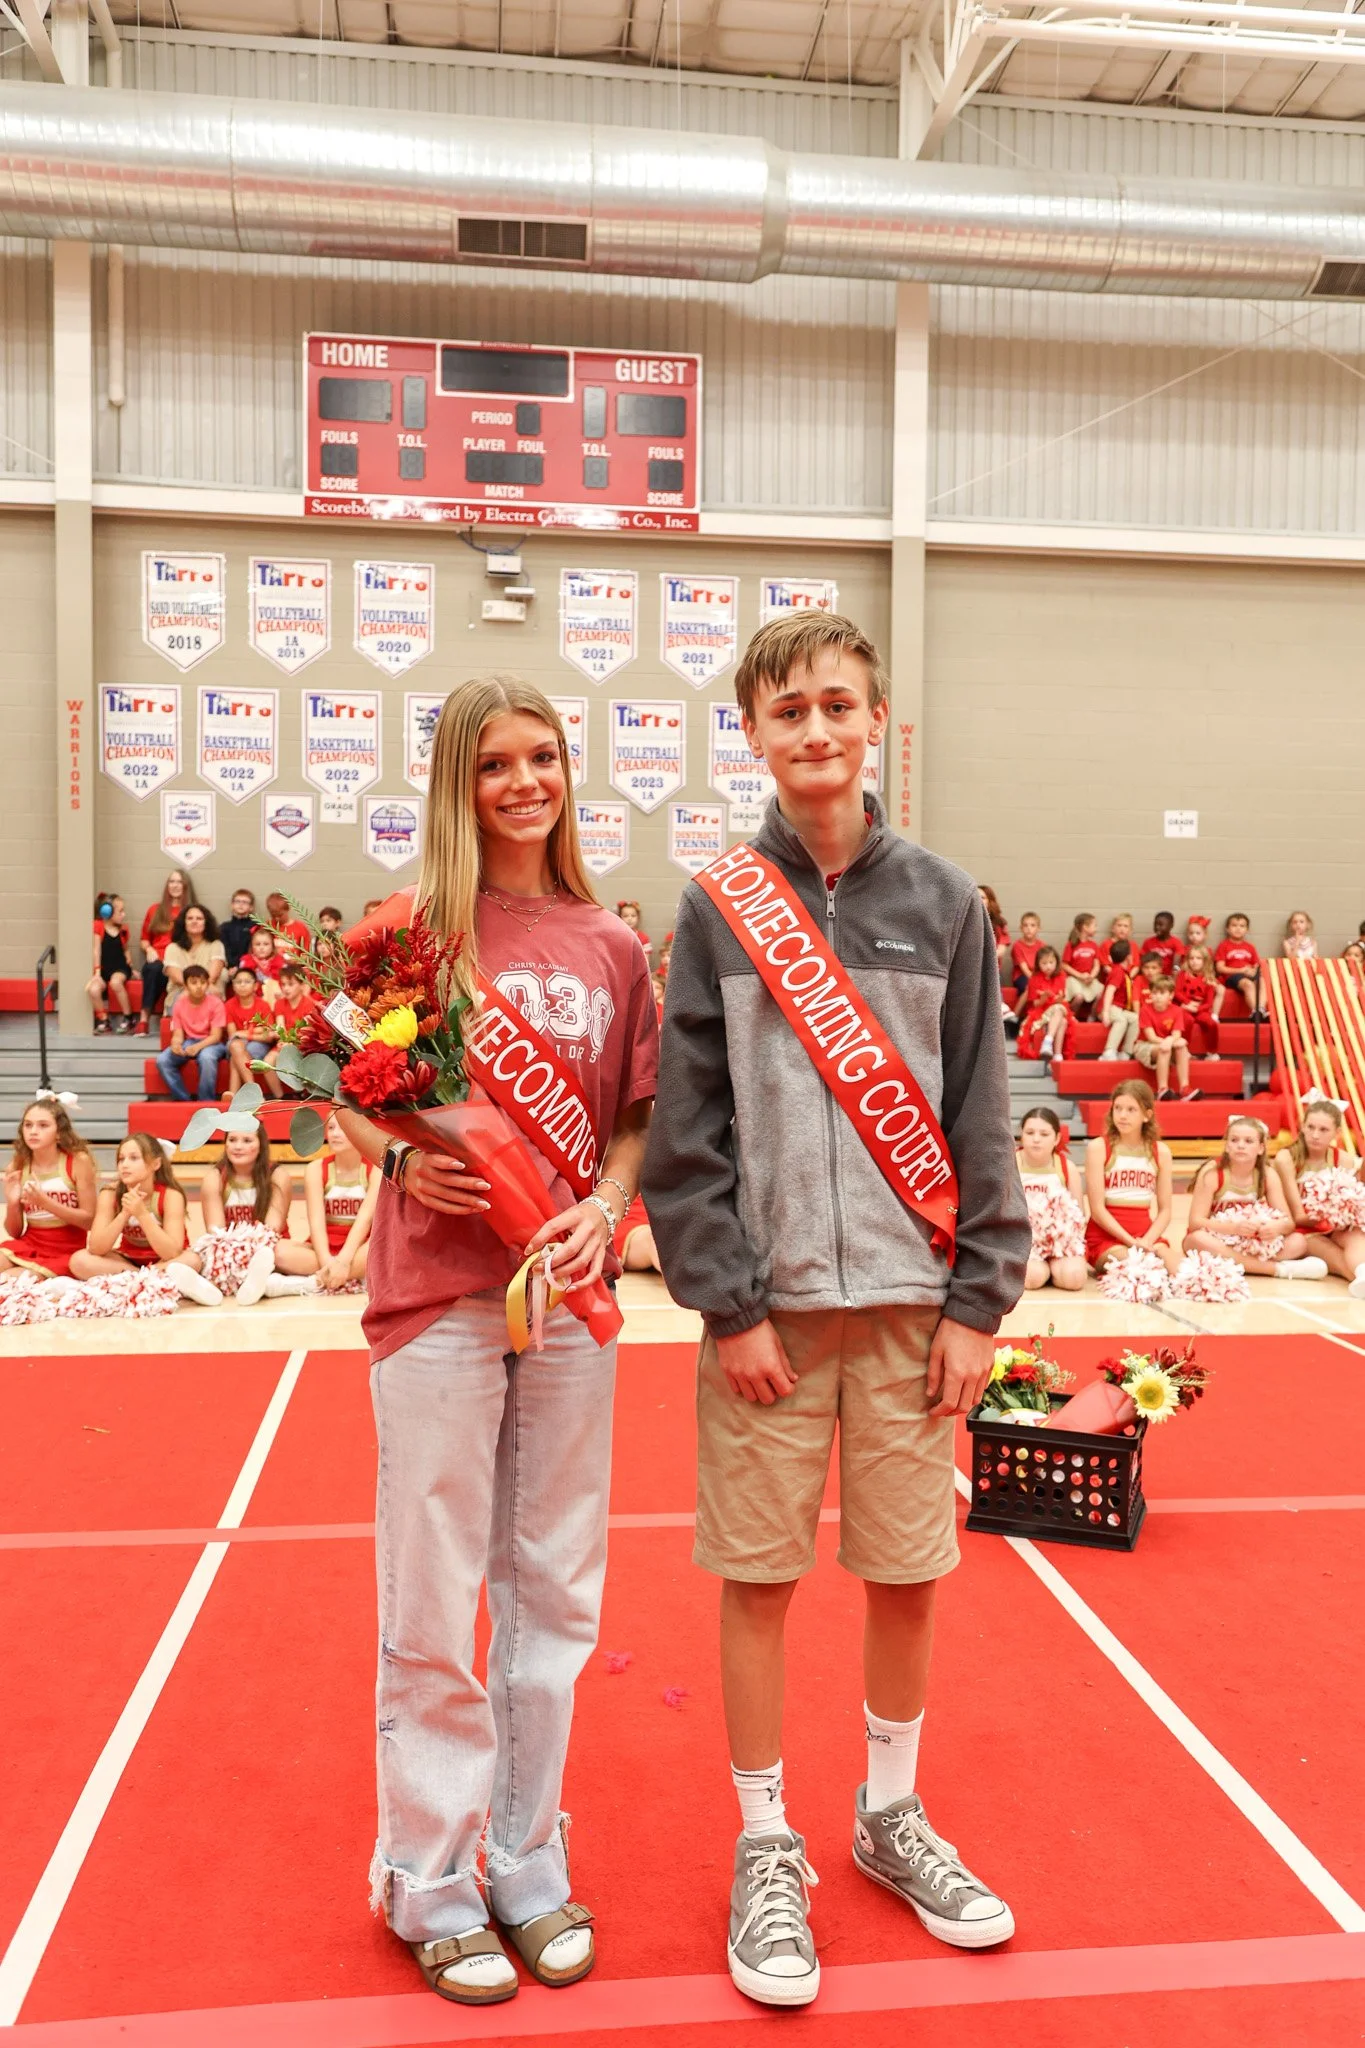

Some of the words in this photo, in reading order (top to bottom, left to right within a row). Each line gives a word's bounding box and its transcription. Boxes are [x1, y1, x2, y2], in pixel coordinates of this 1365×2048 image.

[322, 342, 388, 368] HOME
[615, 358, 688, 384] GUEST
[471, 411, 513, 425] PERIOD
[320, 430, 359, 445] FOULS
[397, 433, 428, 448] T.O.L.
[463, 437, 506, 452] PLAYER
[517, 440, 547, 454] FOUL
[581, 443, 612, 457] T.O.L.
[648, 446, 684, 460] FOULS
[320, 477, 359, 491] SCORE
[484, 485, 524, 498] MATCH
[647, 492, 684, 505] SCORE
[311, 499, 398, 519] Scorebo
[464, 506, 482, 523] by
[486, 508, 535, 523] Electra
[632, 513, 661, 529] Co.,
[664, 515, 692, 528] Inc.
[258, 607, 324, 620] VOLLEYBALL
[362, 609, 427, 624] VOLLEYBALL
[257, 620, 324, 635] CHAMPION
[361, 623, 427, 639] CHAMPION
[168, 636, 202, 649] 2018
[285, 636, 298, 646] 1A
[566, 630, 631, 646] CHAMPION
[277, 648, 305, 658] 2018
[377, 641, 411, 653] 2020
[582, 649, 615, 660] 2021
[682, 653, 713, 664] 2021
[593, 663, 606, 672] 1A
[692, 667, 705, 676] 1A
[106, 733, 175, 746] VOLLEYBALL
[205, 736, 271, 749] BASKETBALL
[309, 738, 375, 751] BASKETBALL
[66, 700, 84, 810] WARRIORS
[106, 746, 174, 761] CHAMPION
[204, 750, 271, 765] CHAMPIONS
[309, 752, 376, 766] CHAMPIONS
[616, 747, 679, 759] VOLLEYBALL
[123, 765, 159, 776] 2022
[220, 767, 255, 779] 2022
[616, 760, 679, 774] CHAMPION
[715, 763, 771, 775] CHAMPIO
[325, 769, 359, 780] 2022
[899, 724, 914, 827] WARRIORS
[135, 779, 148, 788] 1A
[231, 783, 244, 791] 1A
[337, 784, 349, 792] 1A
[631, 777, 664, 788] 2023
[730, 780, 762, 791] 2024
[642, 791, 654, 800] 1A
[740, 794, 752, 803] 1A
[676, 840, 719, 848] TENNIS
[508, 961, 536, 969] CHRIST
[538, 963, 569, 972] ACADEMY
[706, 847, 887, 1083] HOMECOMING
[859, 1080, 953, 1202] COURT
